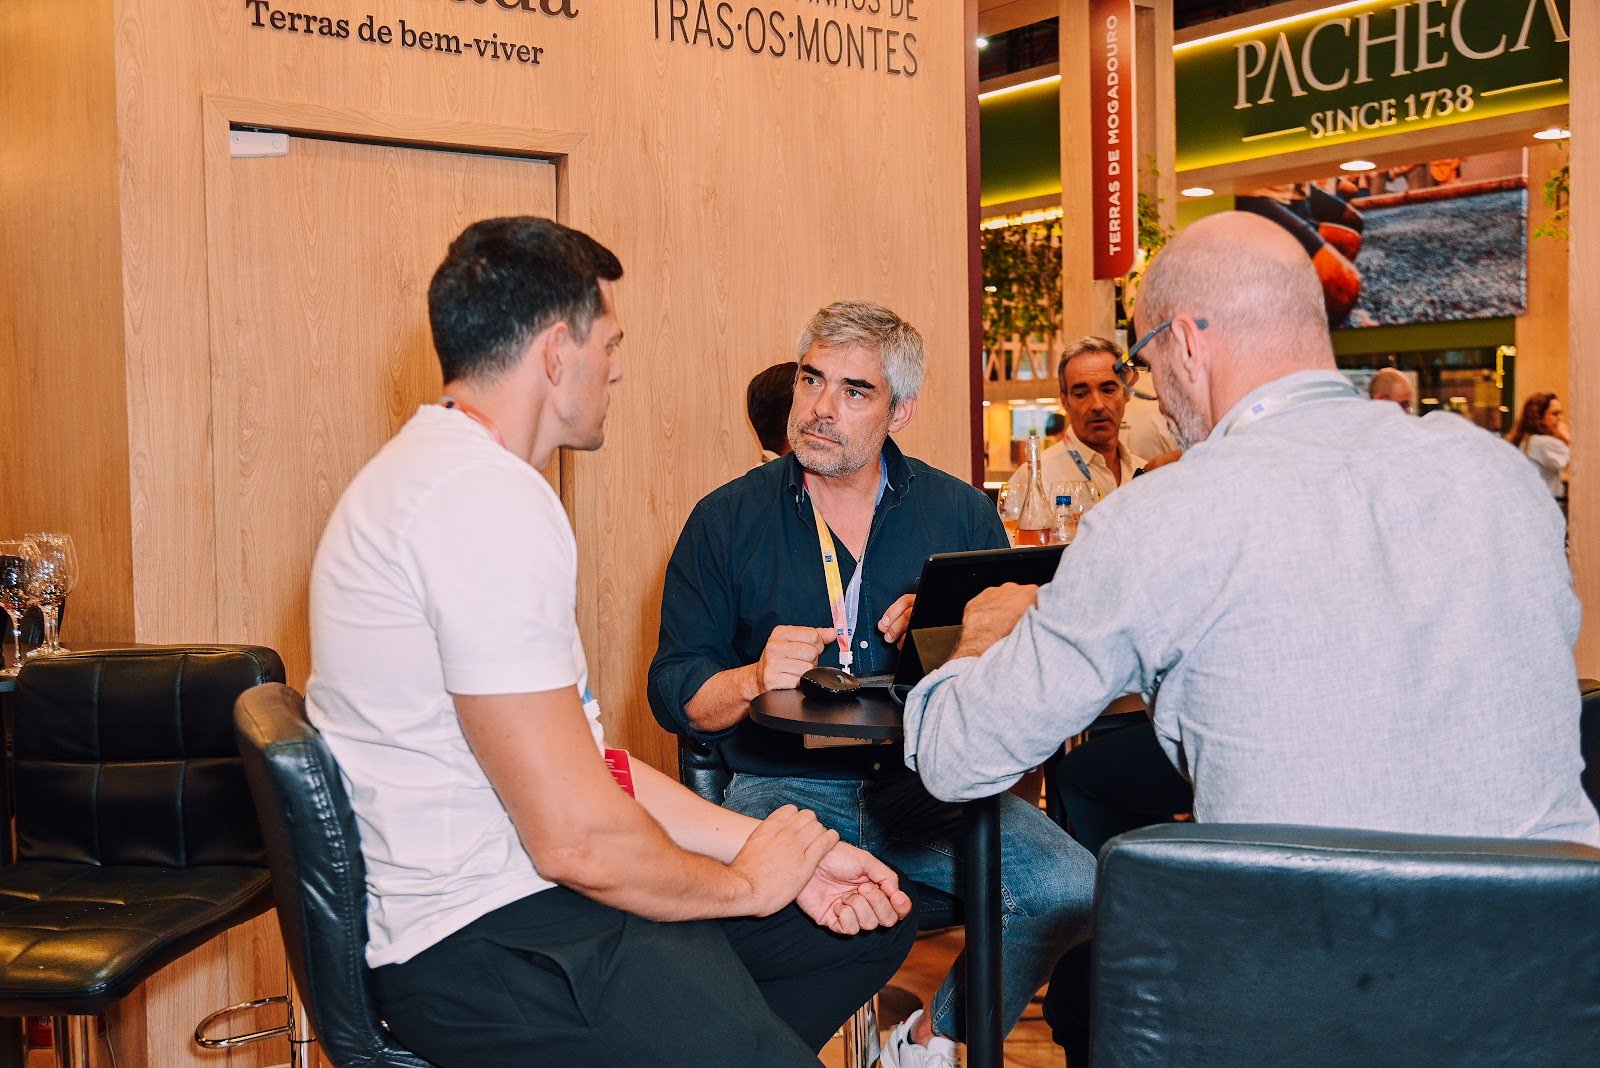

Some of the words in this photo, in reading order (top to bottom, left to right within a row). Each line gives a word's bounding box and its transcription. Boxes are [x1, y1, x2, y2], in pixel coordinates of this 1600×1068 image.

[246, 0, 350, 39] Terras
[358, 15, 393, 44] de
[399, 19, 544, 65] bem-viver
[1106, 15, 1120, 145] MOGADOURO
[1310, 99, 1398, 138] SINCE
[1405, 84, 1474, 121] 1738
[1108, 149, 1121, 175] DE
[1108, 180, 1121, 256] TERRAS
